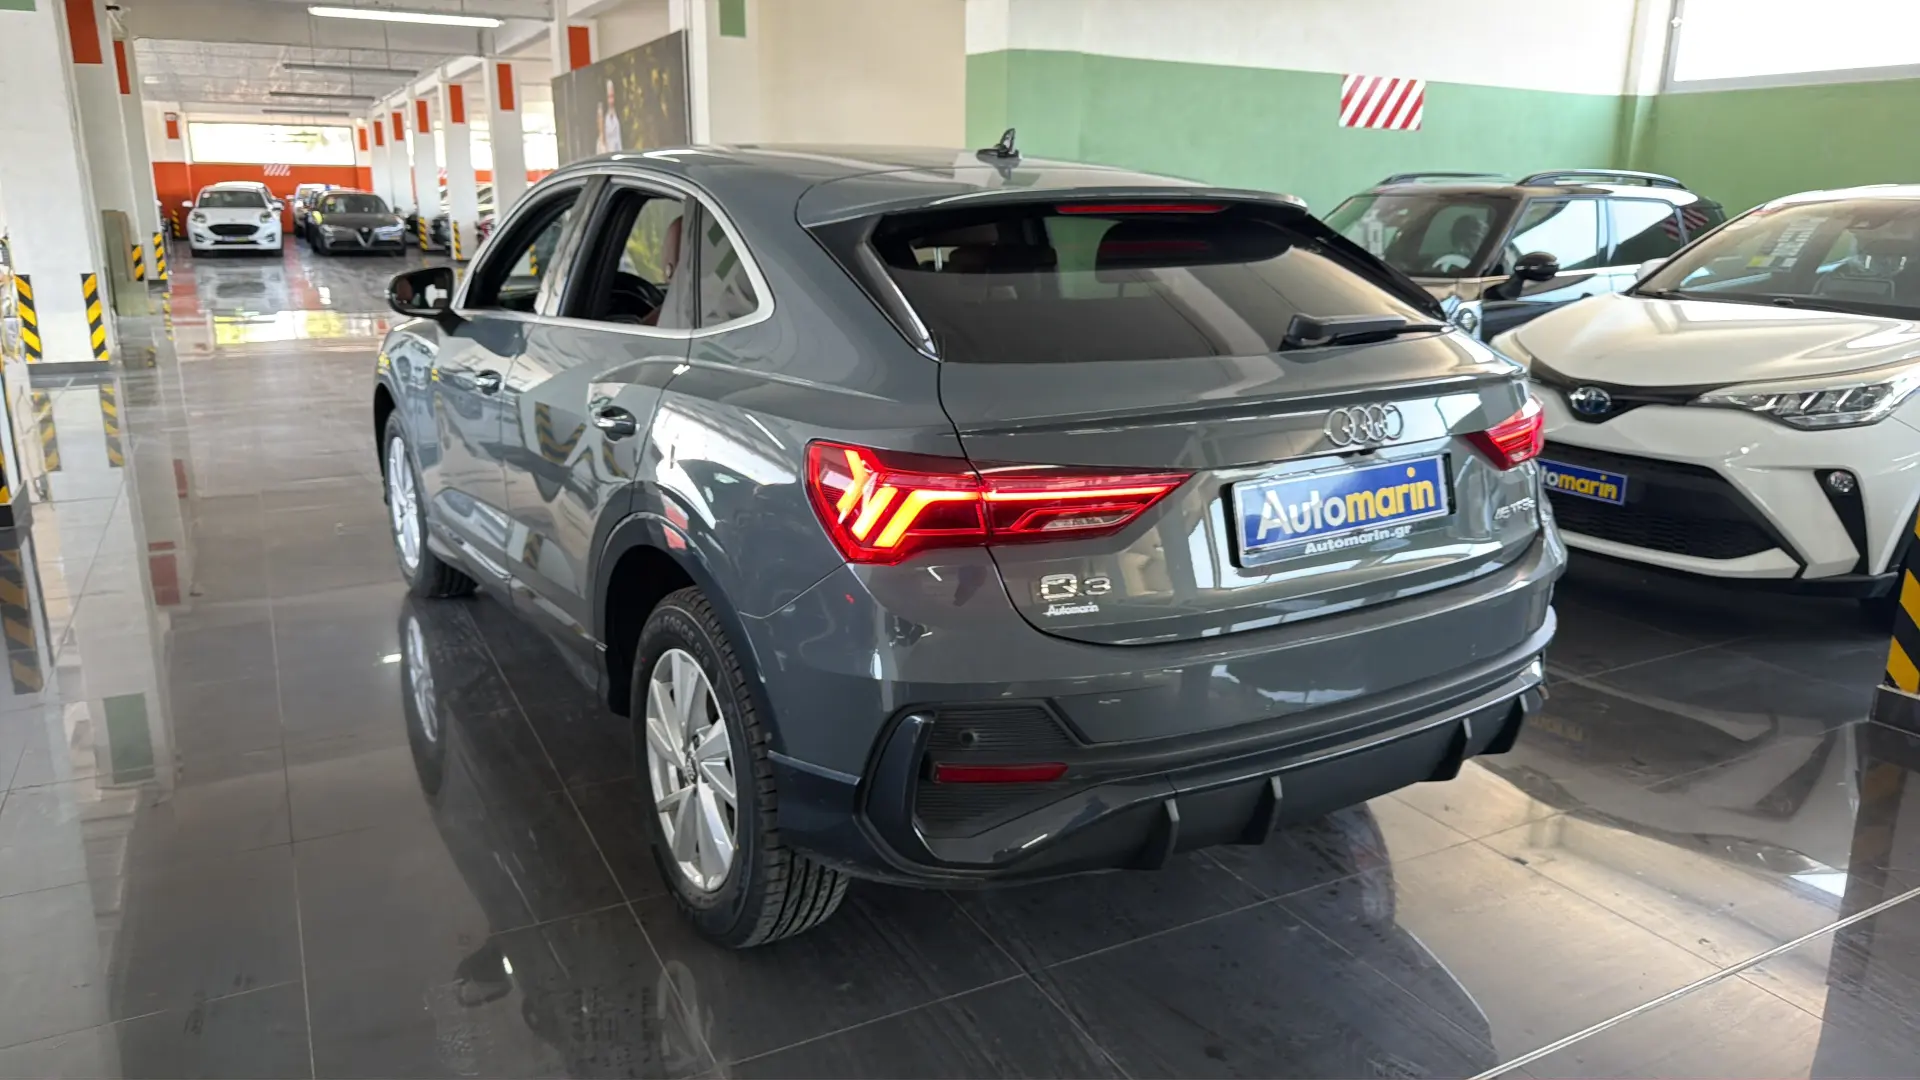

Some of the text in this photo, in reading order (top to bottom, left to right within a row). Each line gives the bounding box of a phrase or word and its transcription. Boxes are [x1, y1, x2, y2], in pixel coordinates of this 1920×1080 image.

[1541, 465, 1618, 500] tomarin
[1257, 466, 1436, 540] Automarin
[1304, 525, 1412, 555] Automarin.gr
[1042, 601, 1100, 617] Automarin
